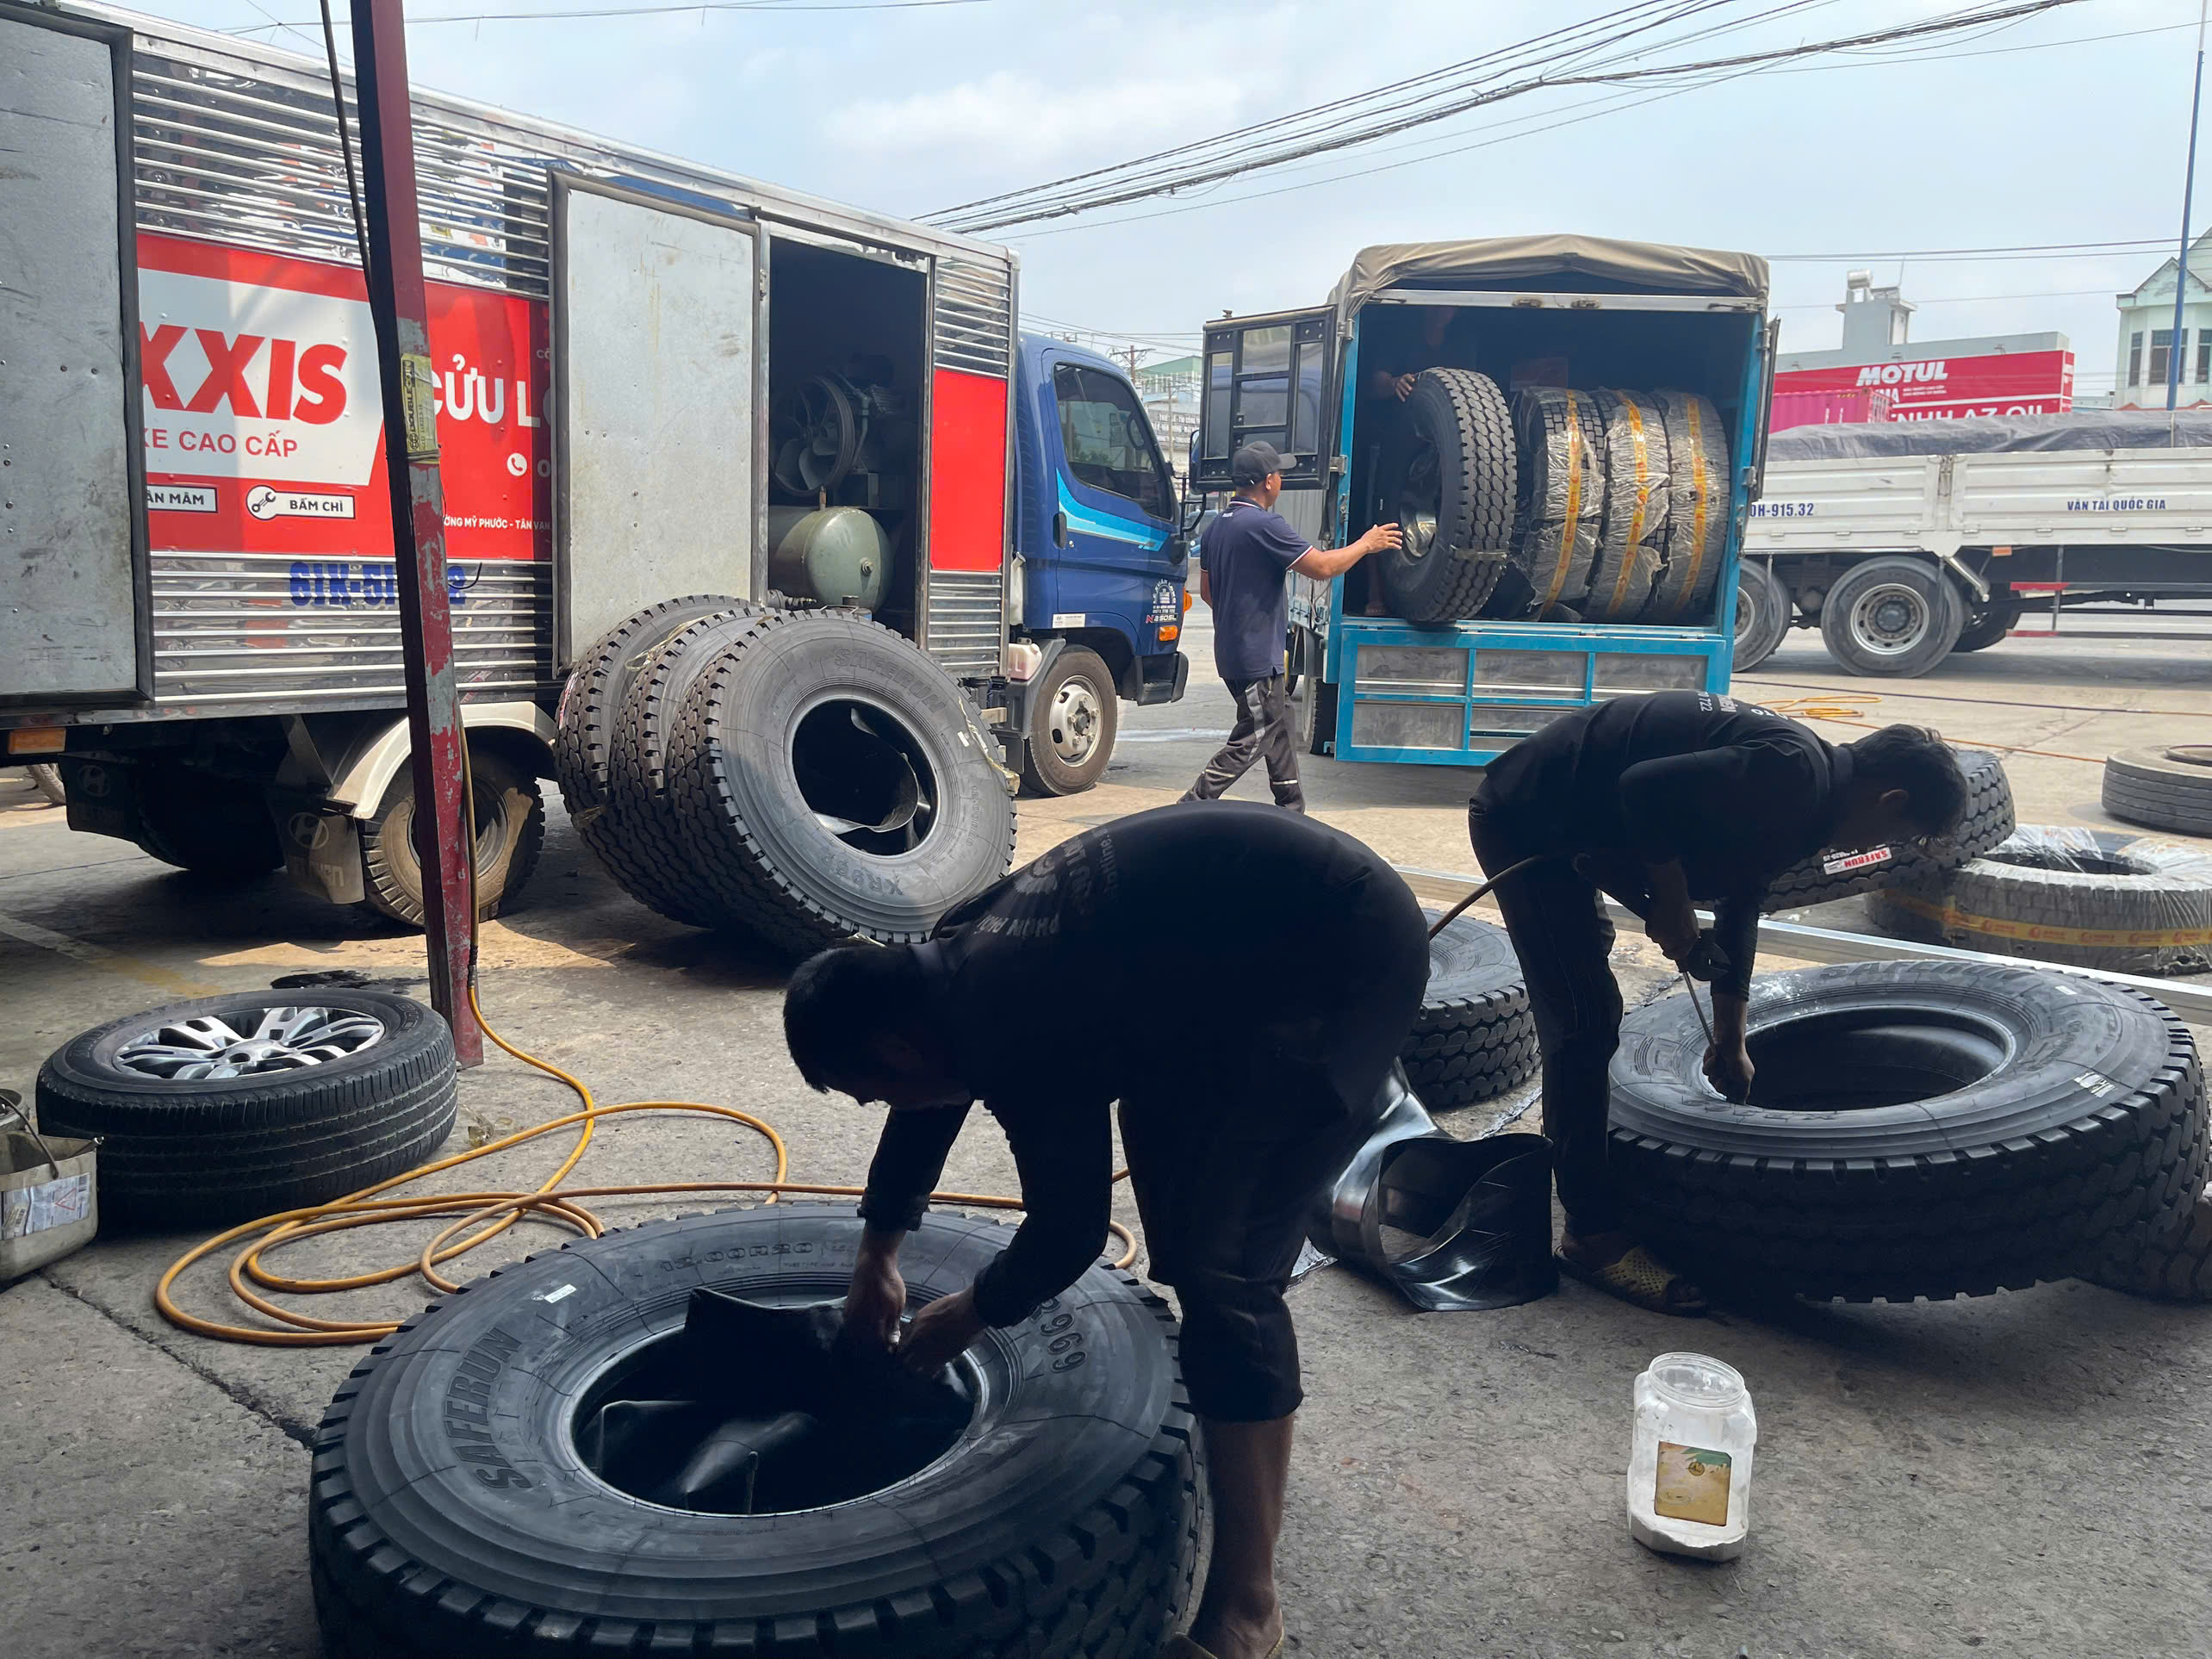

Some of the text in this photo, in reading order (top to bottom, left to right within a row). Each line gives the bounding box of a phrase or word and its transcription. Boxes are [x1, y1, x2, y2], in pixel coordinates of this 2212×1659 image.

[1856, 361, 1948, 386] MOTUL
[1892, 410, 1954, 422] NHH
[178, 430, 236, 454] CAO
[245, 430, 298, 457] CẤP
[169, 492, 205, 505] MÂM
[289, 498, 344, 512] BẤM CHÌ
[2113, 495, 2143, 511] QUỐC
[2147, 500, 2166, 510] GIA
[443, 515, 463, 526] ỜNG
[464, 516, 476, 527] MỸ
[479, 518, 508, 529] PHƯỚC
[515, 519, 532, 530] TÂN
[834, 649, 946, 713] SAFERUN
[1844, 849, 1888, 867] SAFERUN
[1817, 959, 2035, 980] SAFERUN
[443, 1326, 534, 1489] SAFERUN
